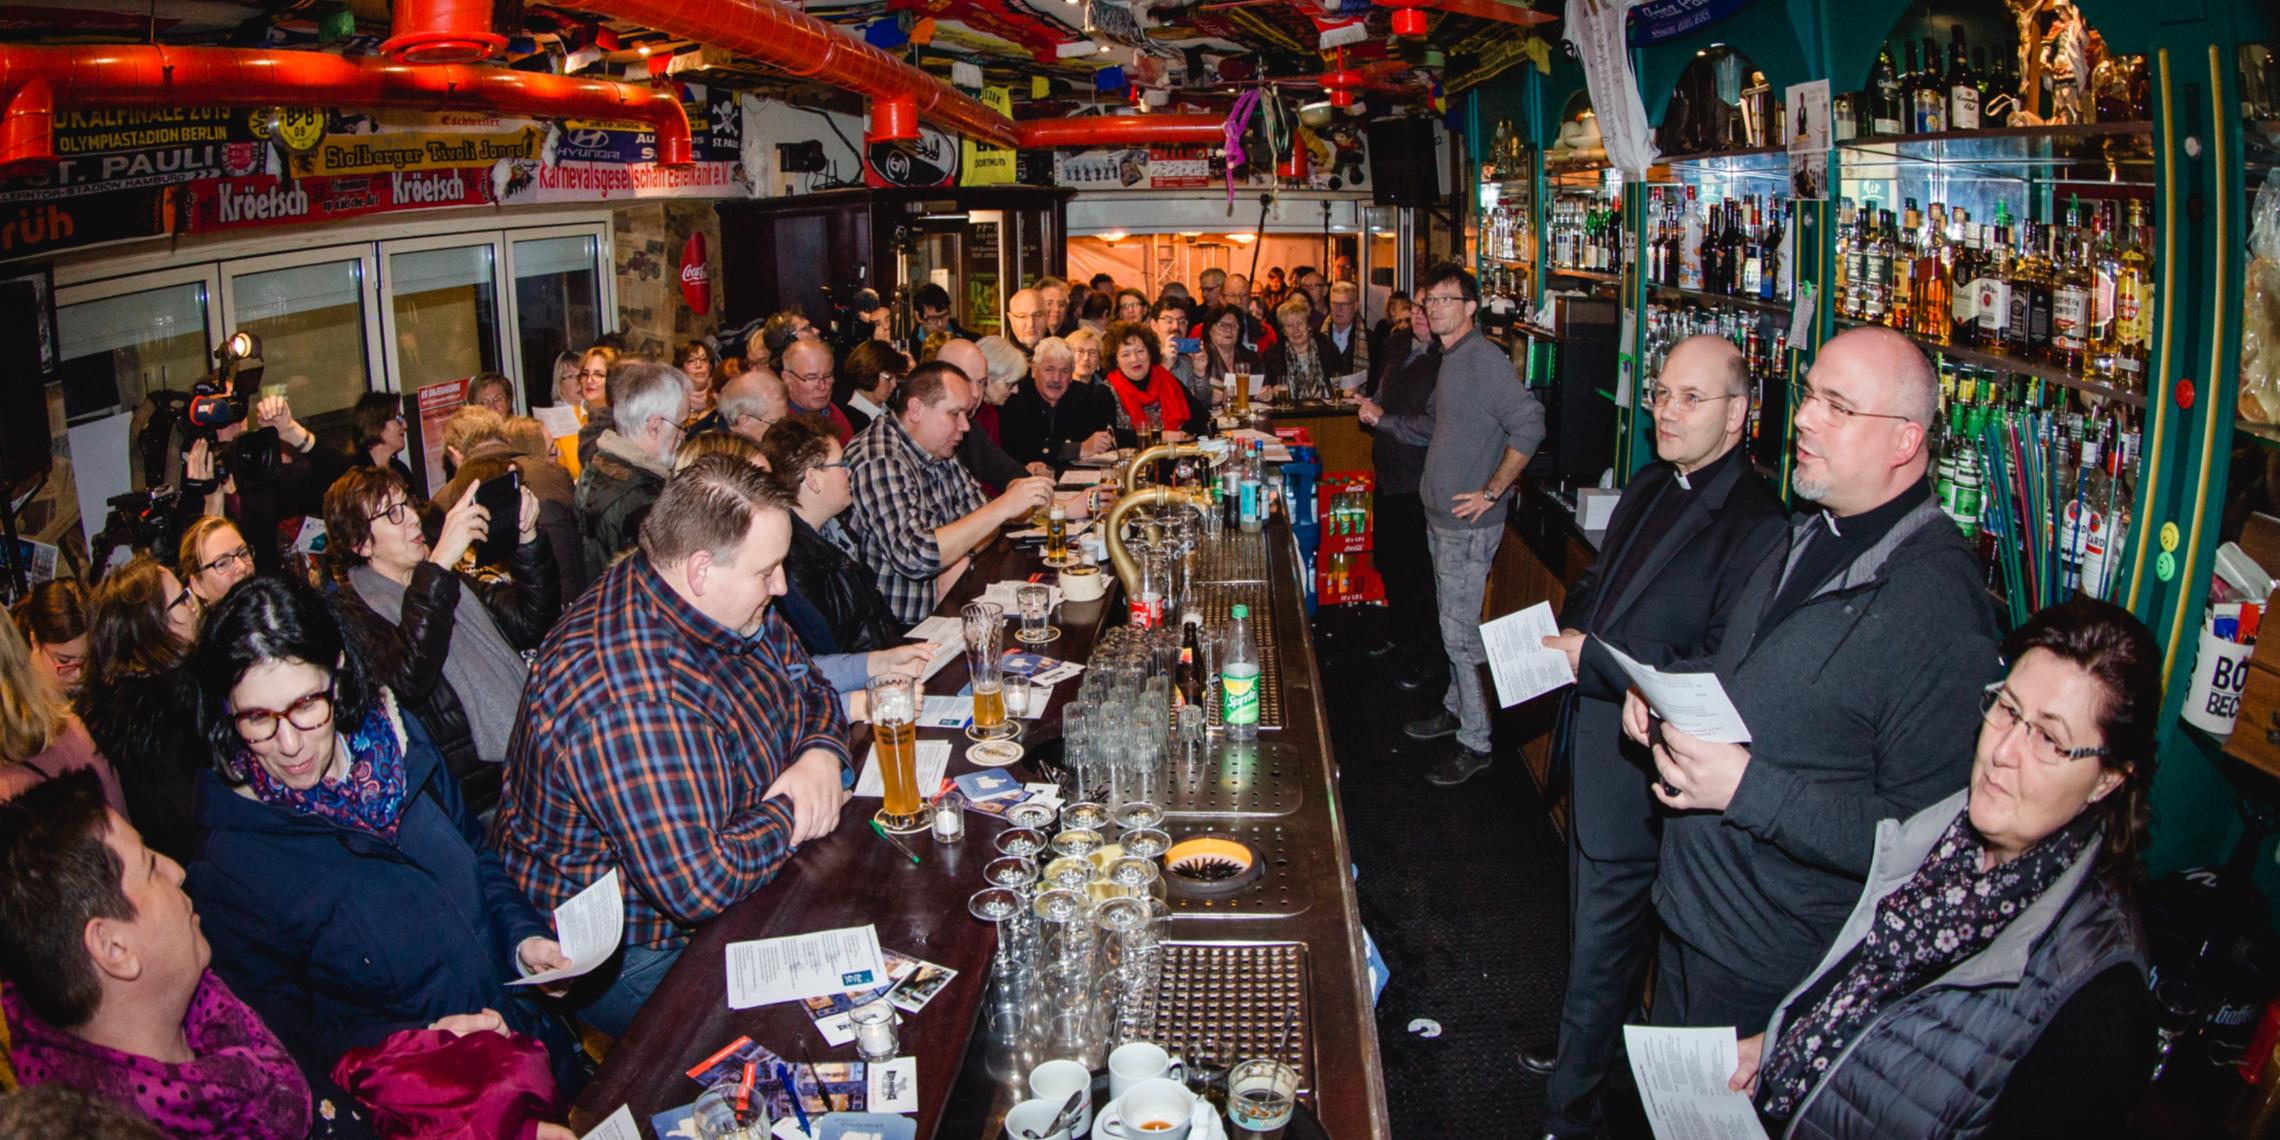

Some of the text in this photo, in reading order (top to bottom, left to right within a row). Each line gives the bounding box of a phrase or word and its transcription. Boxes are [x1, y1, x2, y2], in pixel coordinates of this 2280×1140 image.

[60, 126, 228, 152] OLYMPIASTADION BERLIN
[294, 126, 306, 137] 09
[102, 145, 214, 180] PAULI
[325, 145, 424, 168] Stolberger
[426, 140, 477, 161] Tivoli
[125, 173, 186, 188] HAMBURG
[2, 204, 74, 251] rüh
[2212, 655, 2249, 694] BO
[1227, 690, 1258, 709] Sprite
